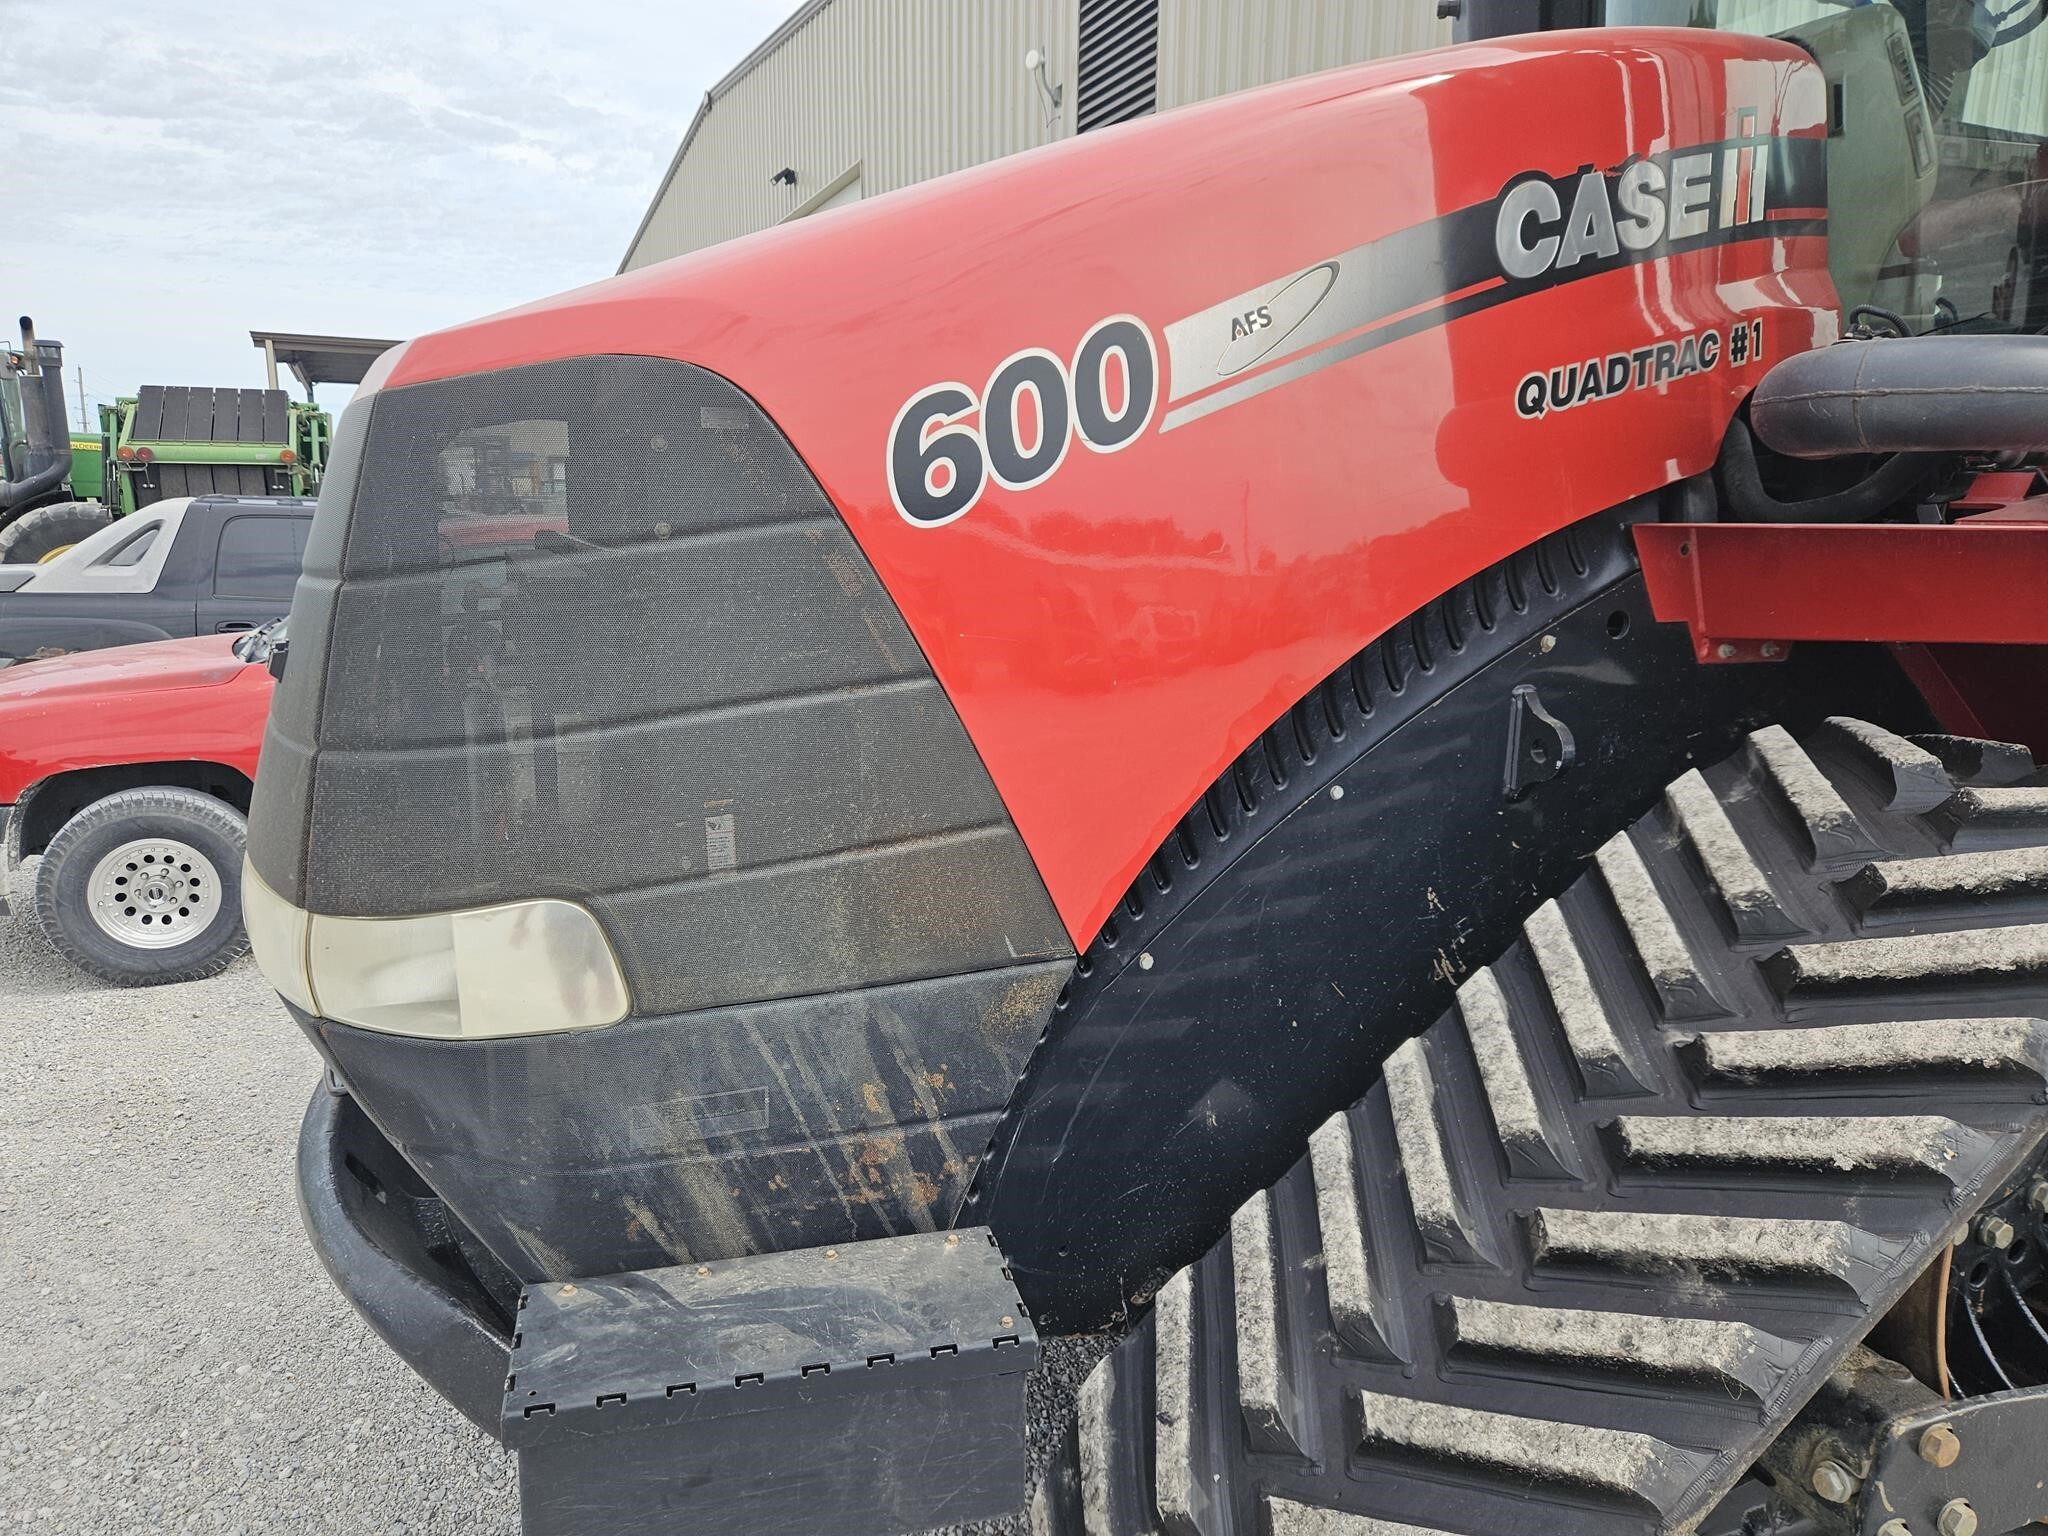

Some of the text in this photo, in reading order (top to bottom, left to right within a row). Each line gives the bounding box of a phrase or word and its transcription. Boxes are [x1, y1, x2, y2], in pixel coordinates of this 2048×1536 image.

[1496, 152, 1713, 279] CASE
[1231, 305, 1273, 342] AFS
[1515, 318, 1763, 419] QUADTRAC #1
[887, 314, 1158, 528] 600
